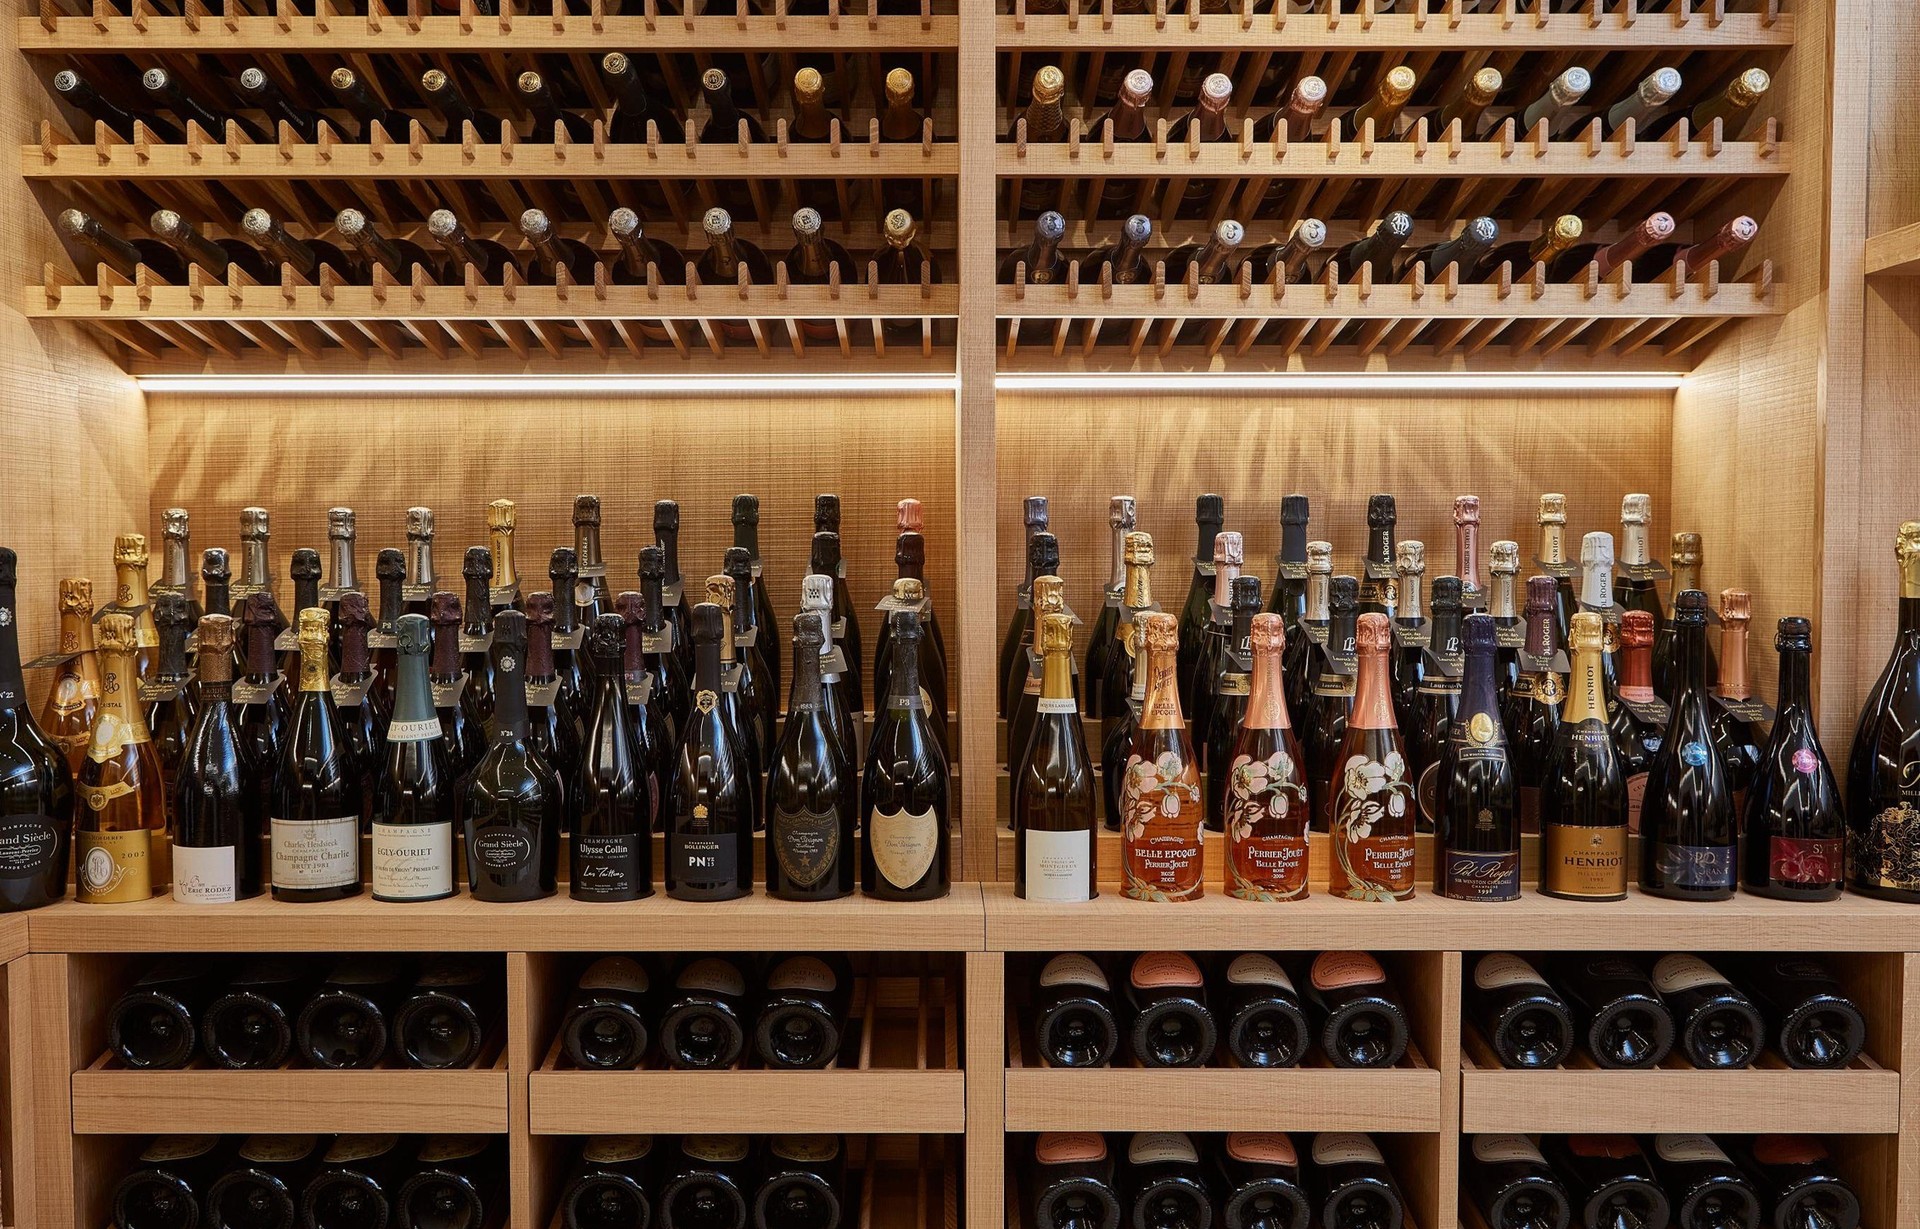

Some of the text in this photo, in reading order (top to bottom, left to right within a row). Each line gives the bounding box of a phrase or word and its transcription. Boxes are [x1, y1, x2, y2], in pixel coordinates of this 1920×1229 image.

[899, 698, 910, 706] P3
[2, 823, 42, 832] HAMPAGNE
[0, 831, 51, 845] and Siècle
[801, 836, 824, 844] Pérignon
[1149, 835, 1185, 845] CHAMPAGNE
[1262, 834, 1295, 842] CHAMPAGNE
[1378, 835, 1409, 843] CHAMPAGNE
[283, 839, 338, 848] Charles Heidsieck
[478, 839, 524, 848] Grand Siècle
[377, 847, 432, 857] EGLY-OURIET
[580, 844, 628, 855] Ulysse Collin
[1135, 848, 1197, 859] BELLE EPOQUE
[121, 851, 145, 859] 2002
[275, 850, 350, 864] Champagne Charlie
[688, 856, 706, 867] PN
[1256, 860, 1299, 868] BELLE EPOQUE
[1373, 860, 1412, 869] BELLE EPOQUE
[1564, 856, 1624, 866] HENRIOT
[583, 865, 596, 877] Les
[1448, 859, 1516, 883] Pol Roger
[205, 886, 232, 894] RODEZ
